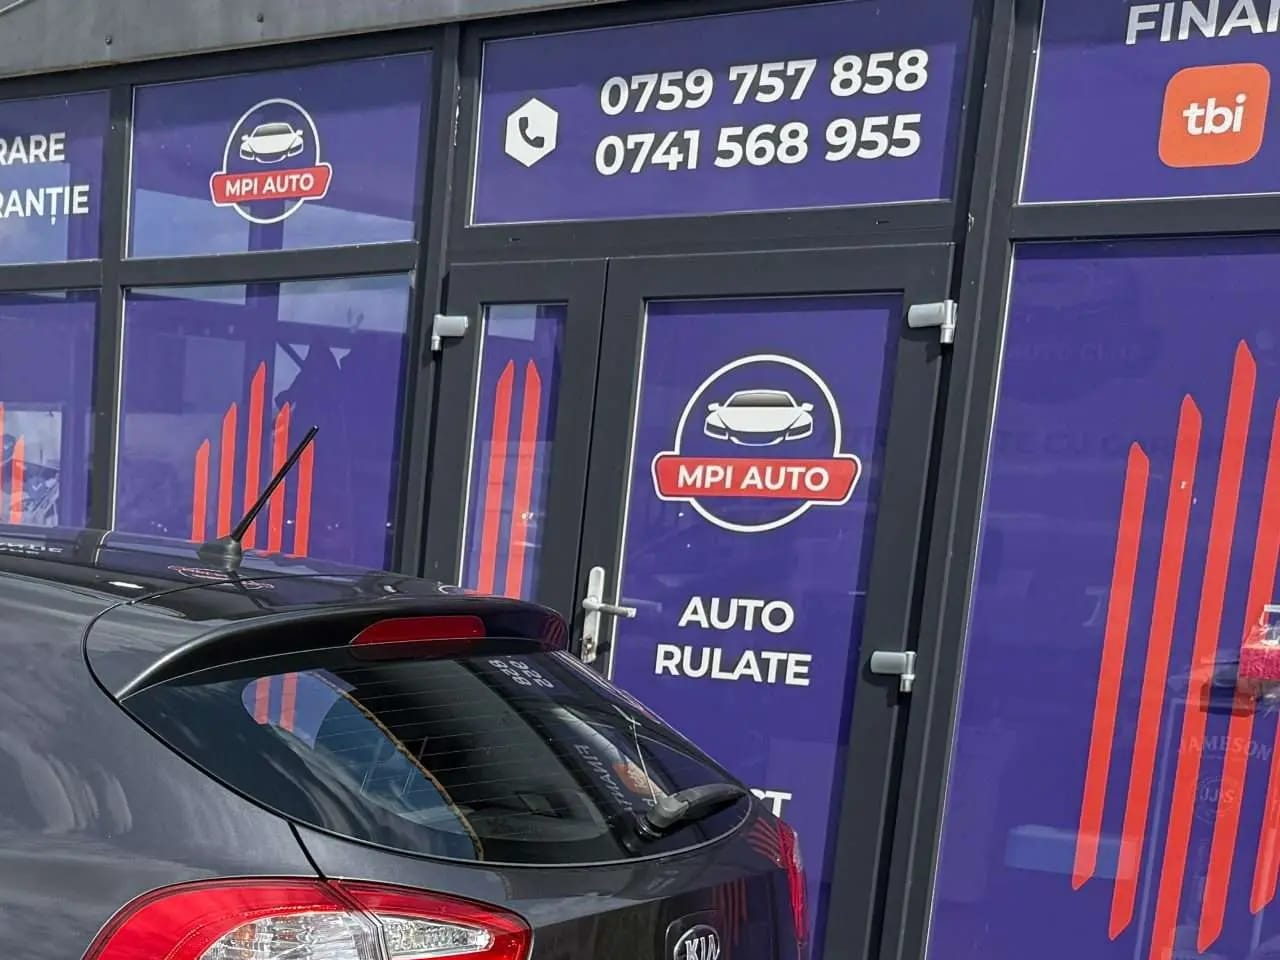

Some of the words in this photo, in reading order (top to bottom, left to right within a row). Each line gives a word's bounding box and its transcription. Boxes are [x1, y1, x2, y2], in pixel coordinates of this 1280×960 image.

[600, 69, 714, 116] 0759
[728, 59, 817, 105] 757
[830, 49, 929, 97] 858
[1183, 93, 1247, 135] tbi
[595, 130, 701, 176] 0741
[714, 121, 809, 168] 568
[825, 113, 922, 161] 955
[225, 178, 258, 197] MPI
[262, 173, 314, 194] AUTO
[677, 464, 733, 489] MPI
[740, 465, 830, 491] AUTO
[678, 596, 795, 633] AUTO
[655, 644, 812, 686] RULATE
